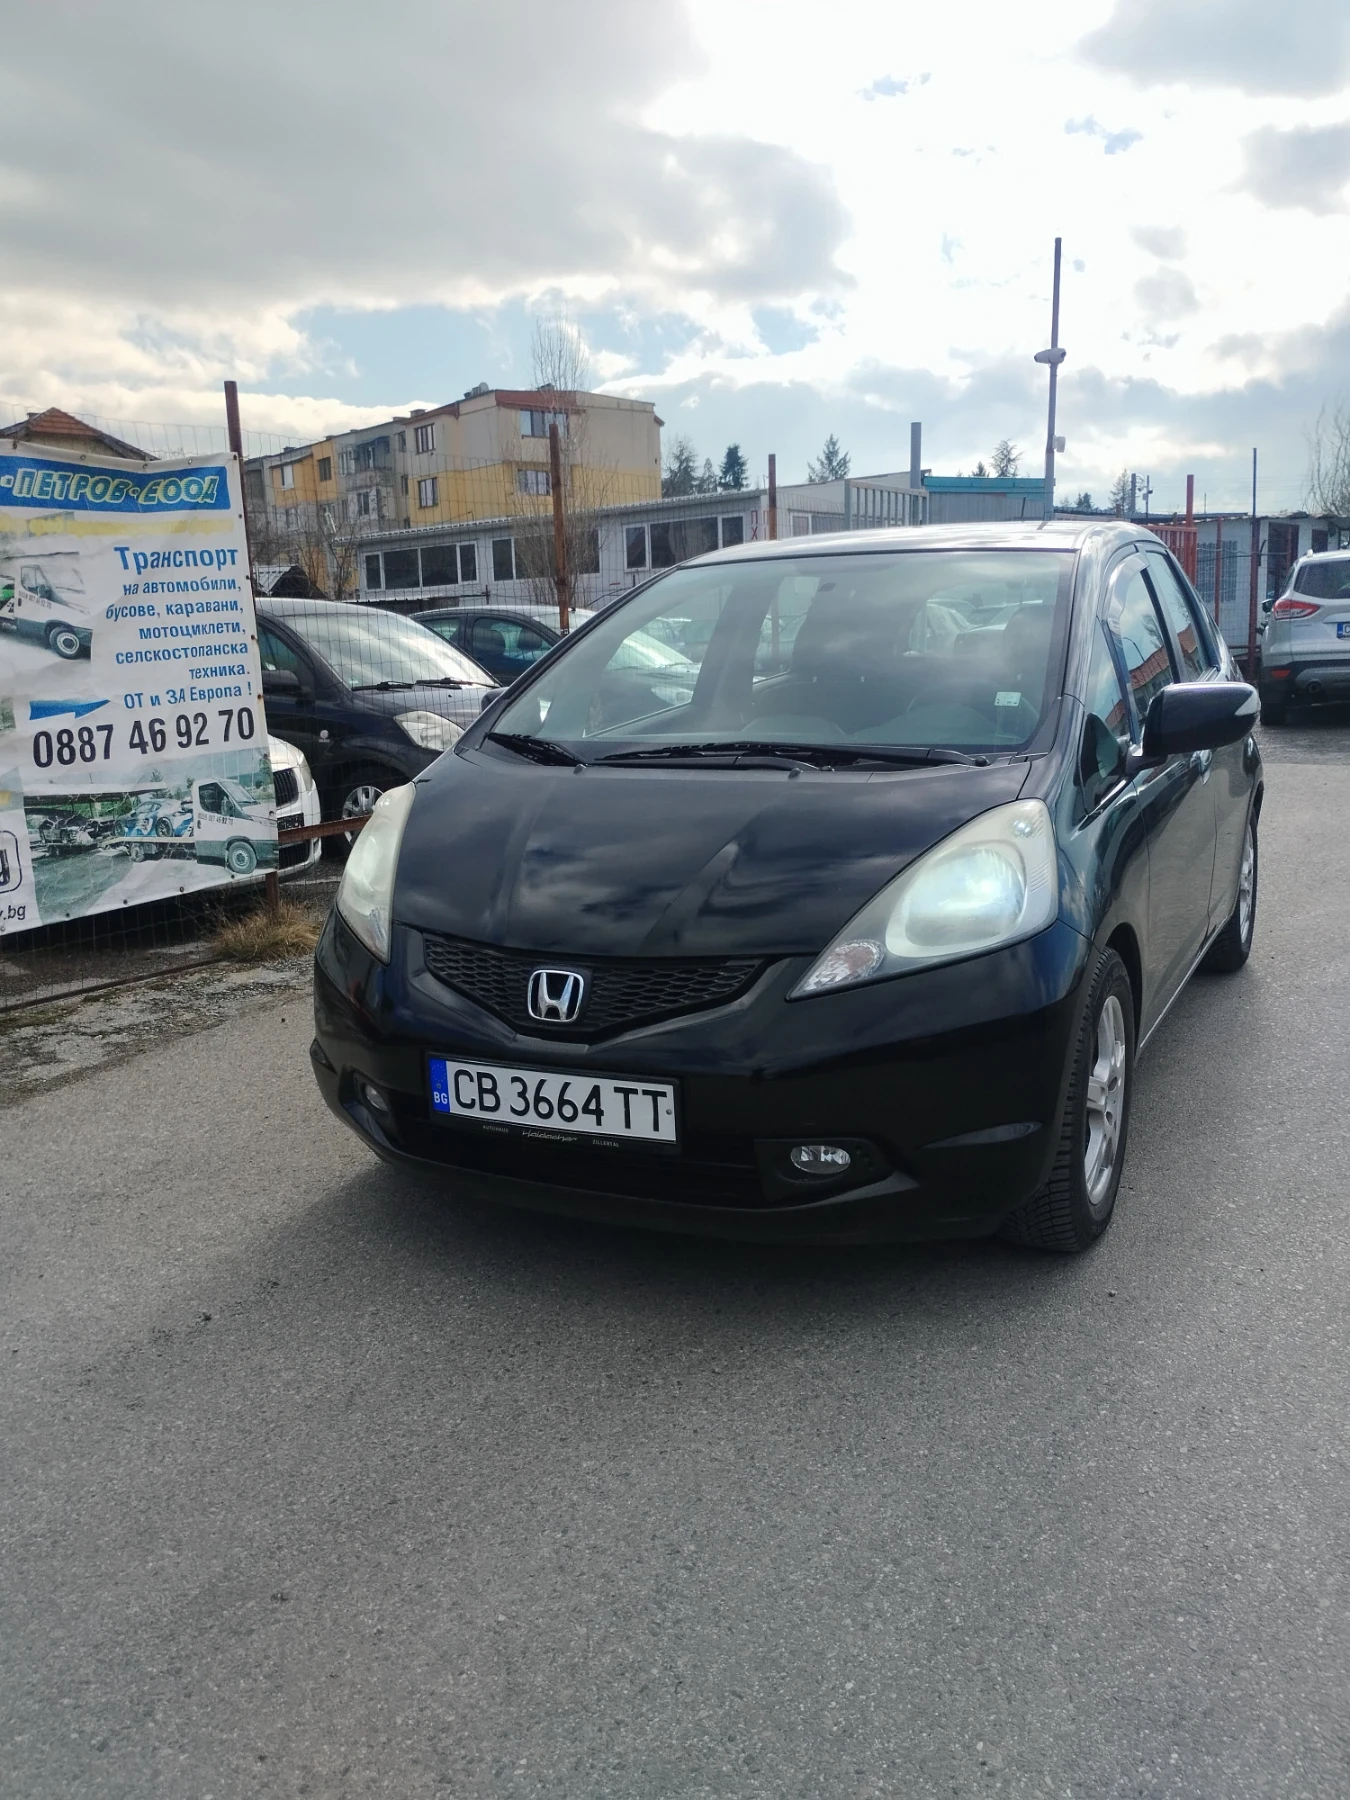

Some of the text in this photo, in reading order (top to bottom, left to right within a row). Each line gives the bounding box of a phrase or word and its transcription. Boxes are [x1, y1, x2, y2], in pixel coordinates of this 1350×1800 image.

[113, 546, 238, 575] Транспорт
[123, 576, 242, 595] на автомобили,
[105, 599, 244, 621] бусове, каравани,
[138, 621, 246, 640] мотоциклети,
[115, 642, 249, 665] селскостопанска
[188, 663, 251, 680] техника.
[123, 692, 144, 709] ОТ
[150, 694, 161, 707] и
[166, 688, 186, 705] ЗА
[190, 684, 242, 703] Европа
[33, 707, 255, 768] 0887 46 92 70
[433, 1092, 448, 1105] BG
[453, 1069, 668, 1132] CB 3664 TT
[592, 1138, 620, 1148] ZILLERTAL
